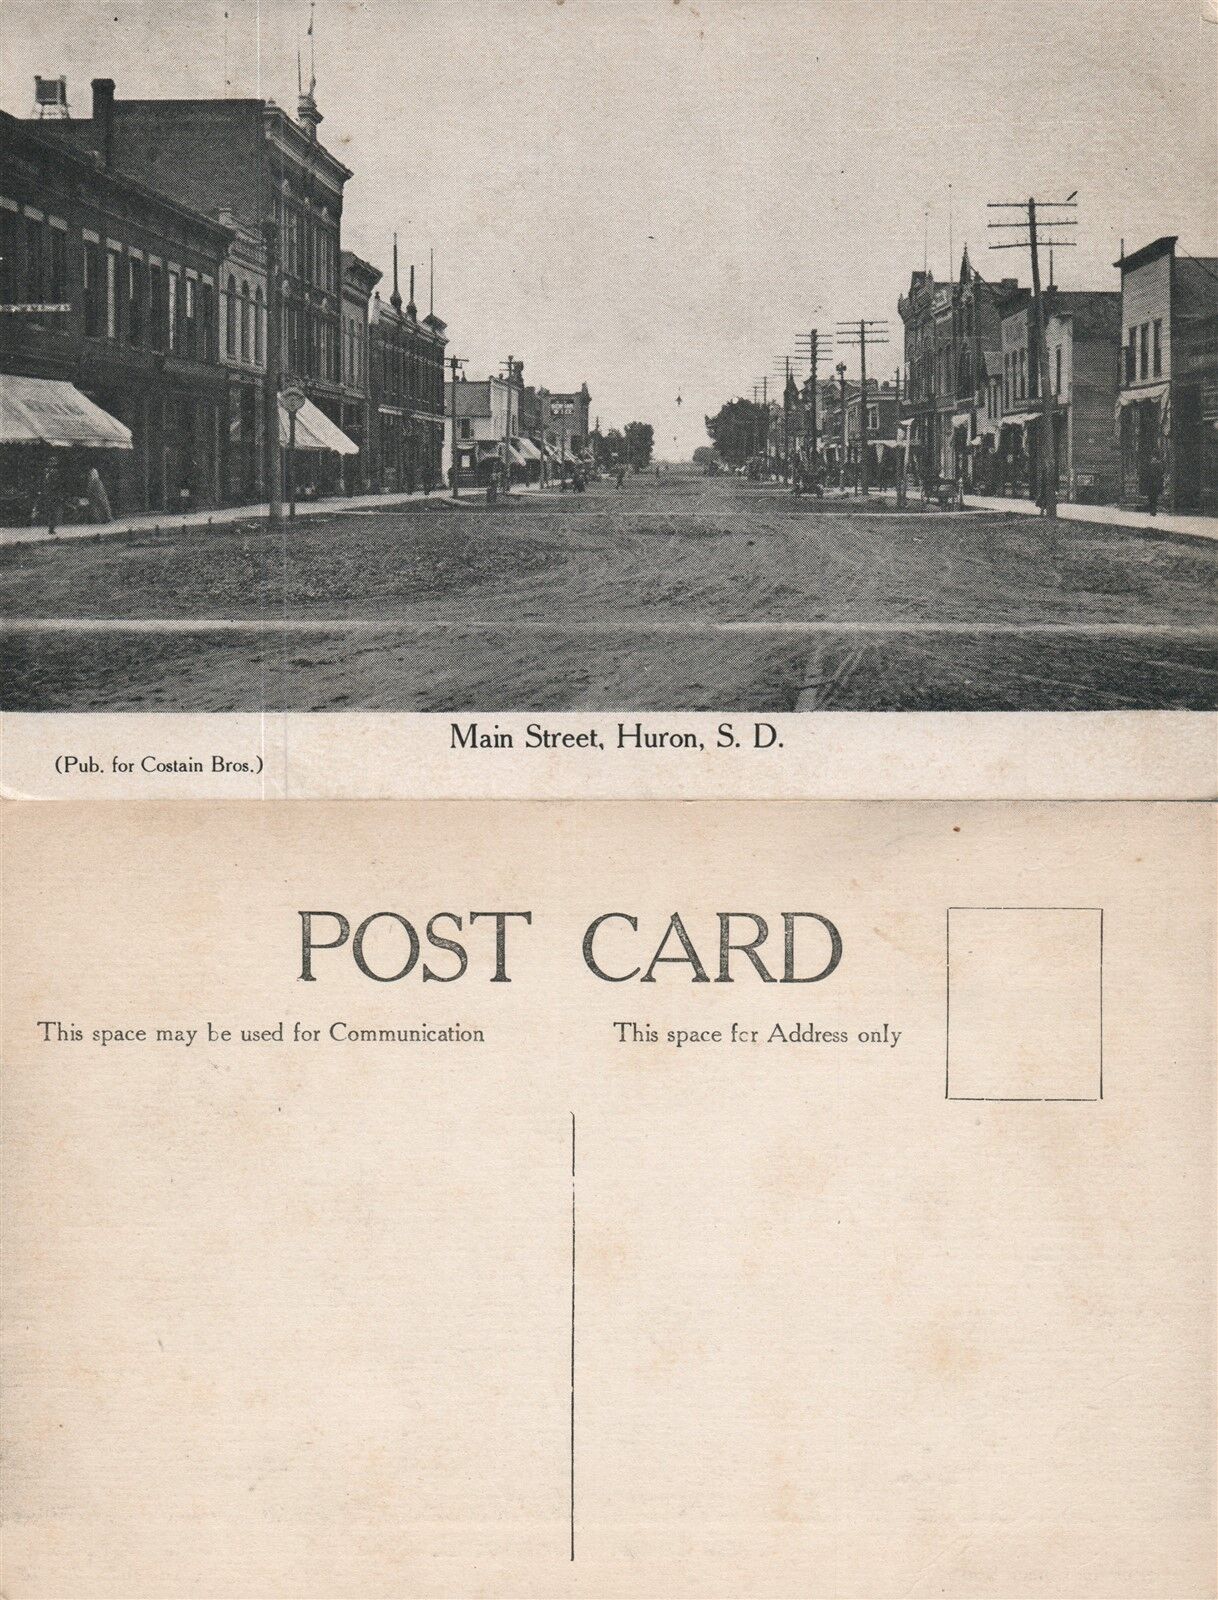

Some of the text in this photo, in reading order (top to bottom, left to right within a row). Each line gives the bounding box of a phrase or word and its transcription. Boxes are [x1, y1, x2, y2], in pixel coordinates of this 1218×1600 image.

[450, 723, 784, 751] Main Street, Huron, S. D.
[55, 755, 264, 775] (Pub. for Costain Bros.)
[297, 910, 843, 984] POST CARD
[37, 1021, 485, 1047] This space may be used for Communication
[612, 1021, 902, 1048] This space for Address only
